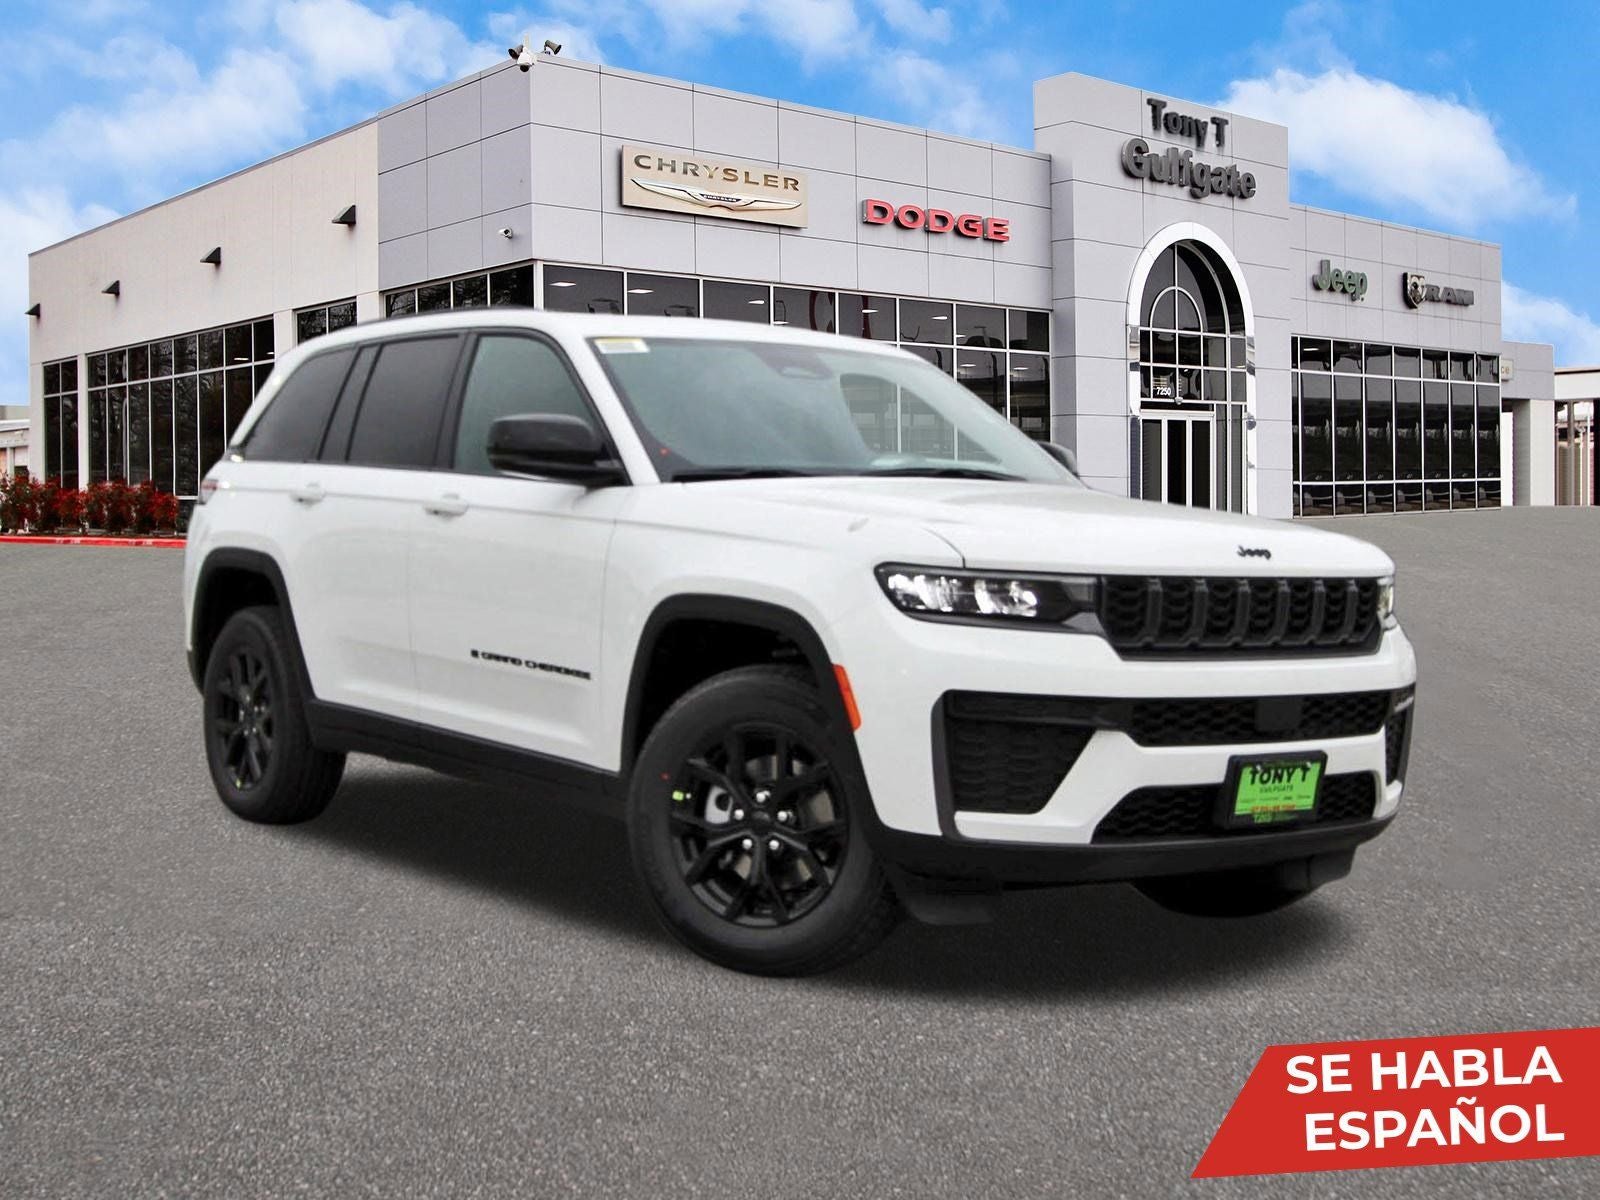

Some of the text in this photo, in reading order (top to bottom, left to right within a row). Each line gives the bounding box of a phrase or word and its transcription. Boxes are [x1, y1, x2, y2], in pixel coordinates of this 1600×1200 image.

[1146, 97, 1230, 148] Tony T
[633, 153, 801, 193] CHRYSLER
[1121, 137, 1257, 199] Gulfgate
[862, 197, 1011, 243] DODGE
[1311, 259, 1368, 302] Jeep
[1424, 283, 1475, 307] RAM
[1156, 387, 1171, 396] 7250
[1236, 544, 1272, 561] Jeep
[1250, 765, 1311, 785] TONY T
